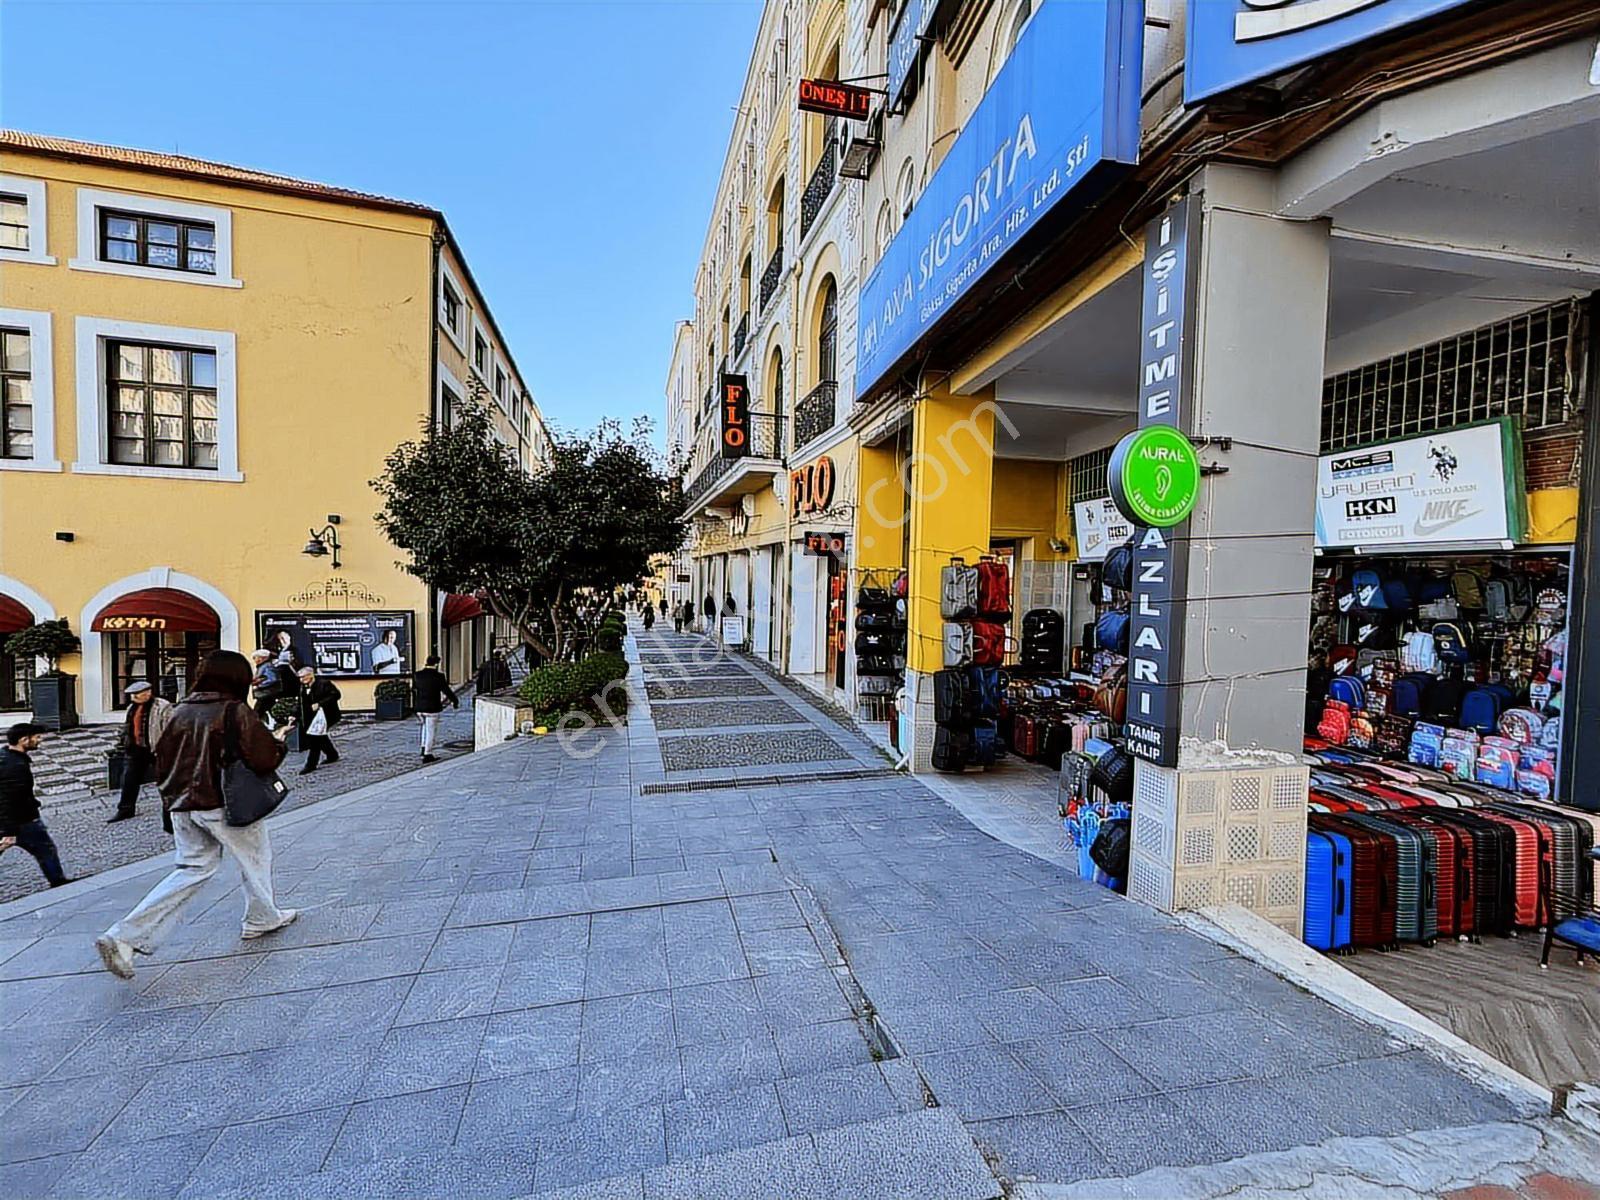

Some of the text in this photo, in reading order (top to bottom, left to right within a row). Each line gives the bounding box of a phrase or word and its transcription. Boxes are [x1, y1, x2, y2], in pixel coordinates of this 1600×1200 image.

[1033, 168, 1061, 209] Ltd.
[918, 113, 1037, 291] SİGORTA
[1144, 217, 1177, 418] İŞİTME
[725, 384, 744, 446] FLO
[1139, 446, 1186, 463] AURAL
[1333, 452, 1391, 470] MCS
[791, 455, 836, 518] FLO
[1348, 499, 1393, 516] HKN
[1422, 499, 1471, 520] NIKE
[808, 537, 843, 551] FLO
[1134, 528, 1168, 715] AZLARI
[1128, 723, 1162, 746] TAMİR
[1127, 738, 1161, 760] KALIP
